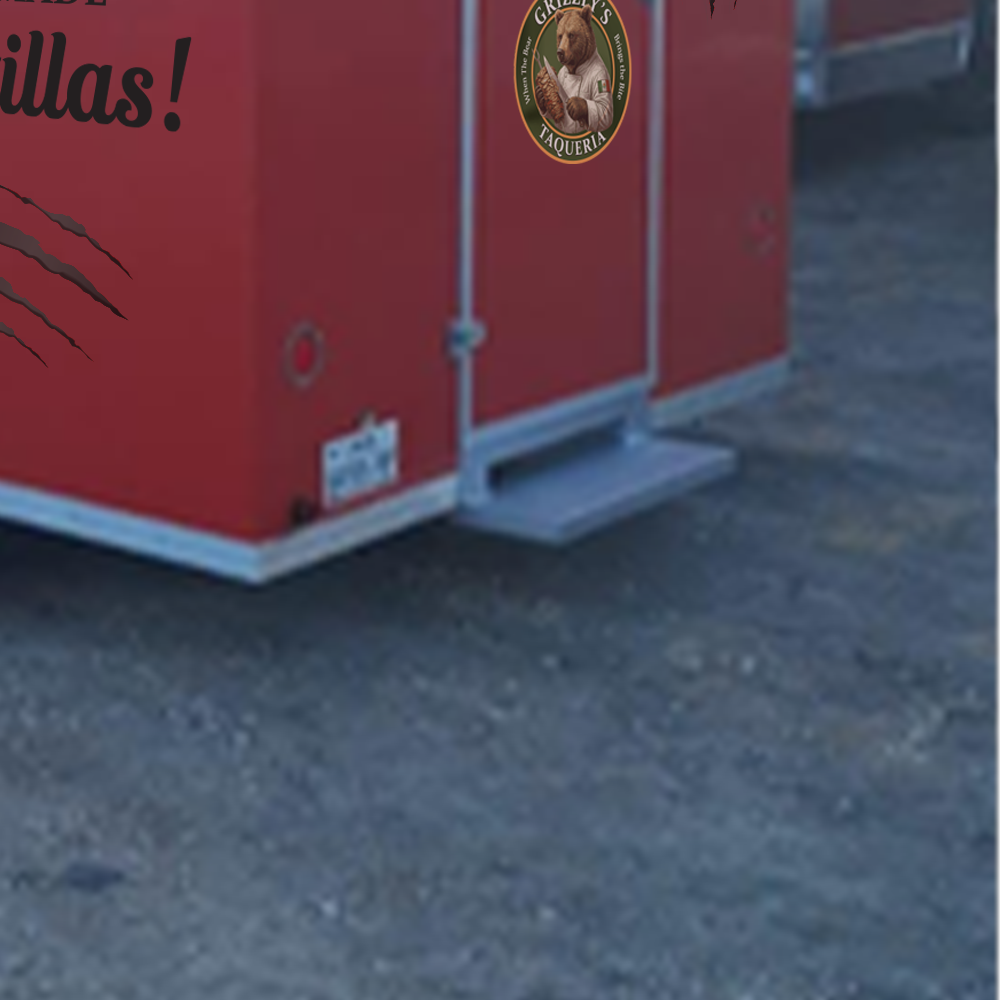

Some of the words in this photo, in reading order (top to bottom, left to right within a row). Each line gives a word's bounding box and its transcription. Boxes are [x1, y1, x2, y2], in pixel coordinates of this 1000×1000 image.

[522, 36, 532, 56] Bear
[613, 33, 624, 63] Brings
[616, 82, 625, 101] Bite
[539, 123, 606, 157] TAQUERIA
